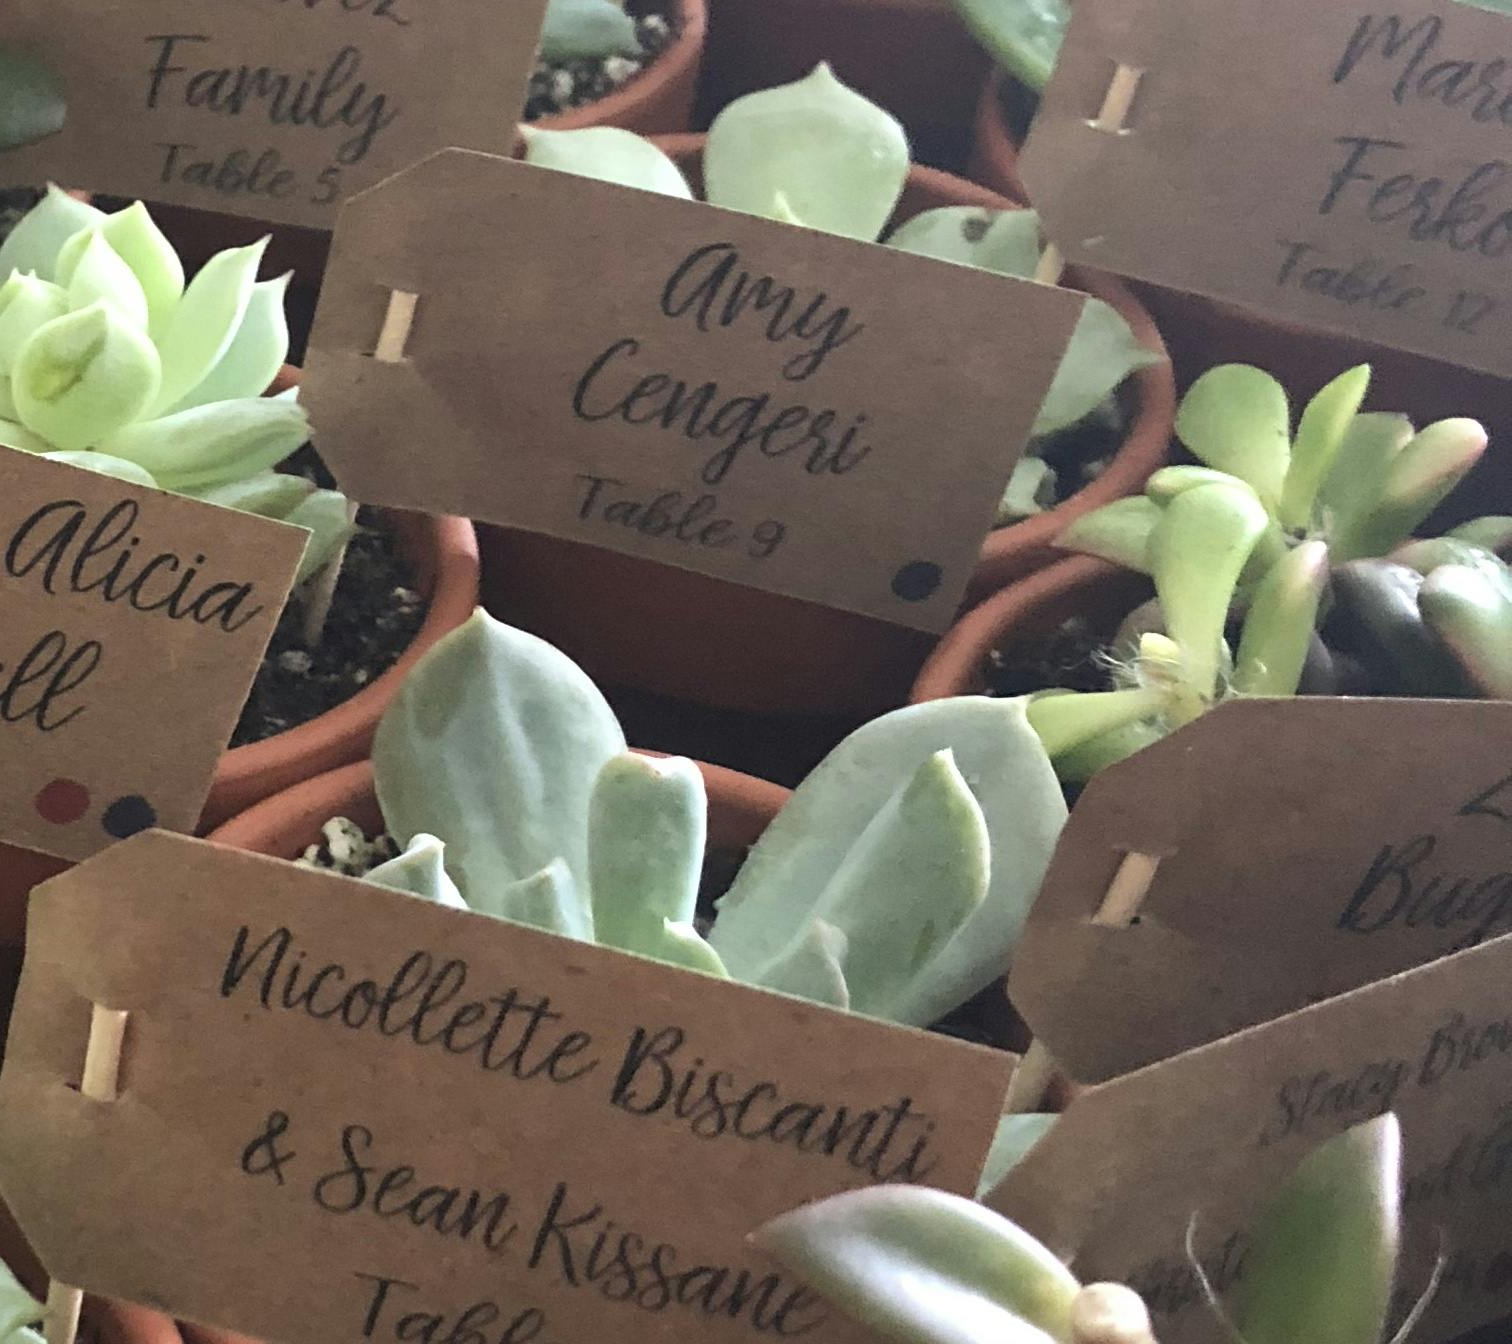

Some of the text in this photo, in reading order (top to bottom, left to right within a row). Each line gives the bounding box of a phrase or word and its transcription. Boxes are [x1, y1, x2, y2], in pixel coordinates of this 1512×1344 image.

[144, 33, 400, 165] Family
[152, 142, 341, 204] Table 5
[660, 241, 864, 382] Amy
[1276, 238, 1426, 309] Table
[572, 338, 874, 485] Cengeri
[5, 497, 264, 633] Alicia
[576, 472, 786, 558] Table 9
[220, 923, 940, 1179] Nicollette Biscanti
[240, 1109, 831, 1337] & Sean Kissane
